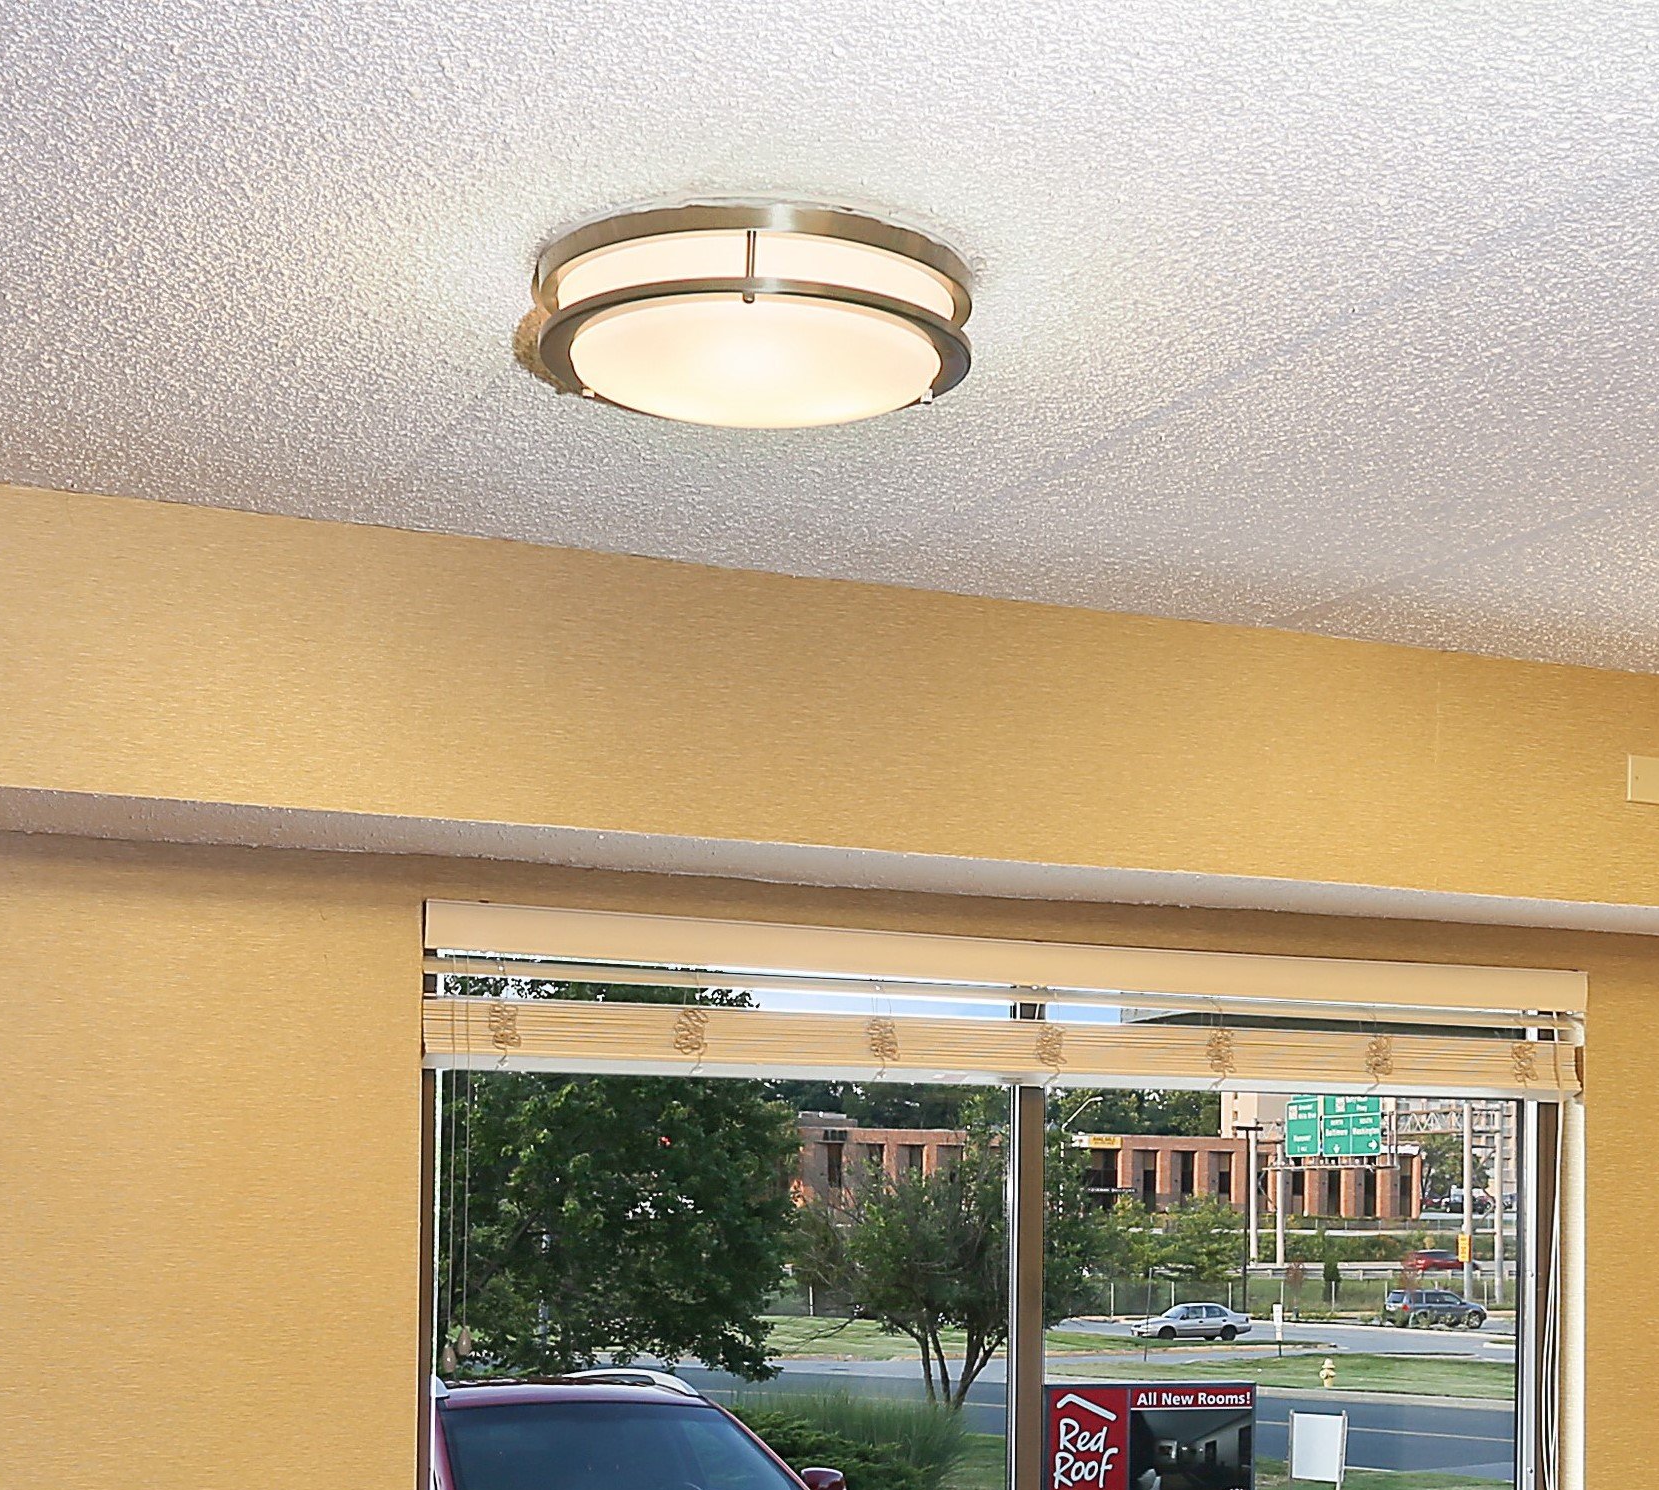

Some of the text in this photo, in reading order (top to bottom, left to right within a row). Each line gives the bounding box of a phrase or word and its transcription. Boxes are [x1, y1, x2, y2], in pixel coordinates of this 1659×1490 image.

[1137, 1391, 1251, 1406] All New Rooms!
[1059, 1418, 1109, 1453] Red
[1053, 1447, 1118, 1490] Roof
